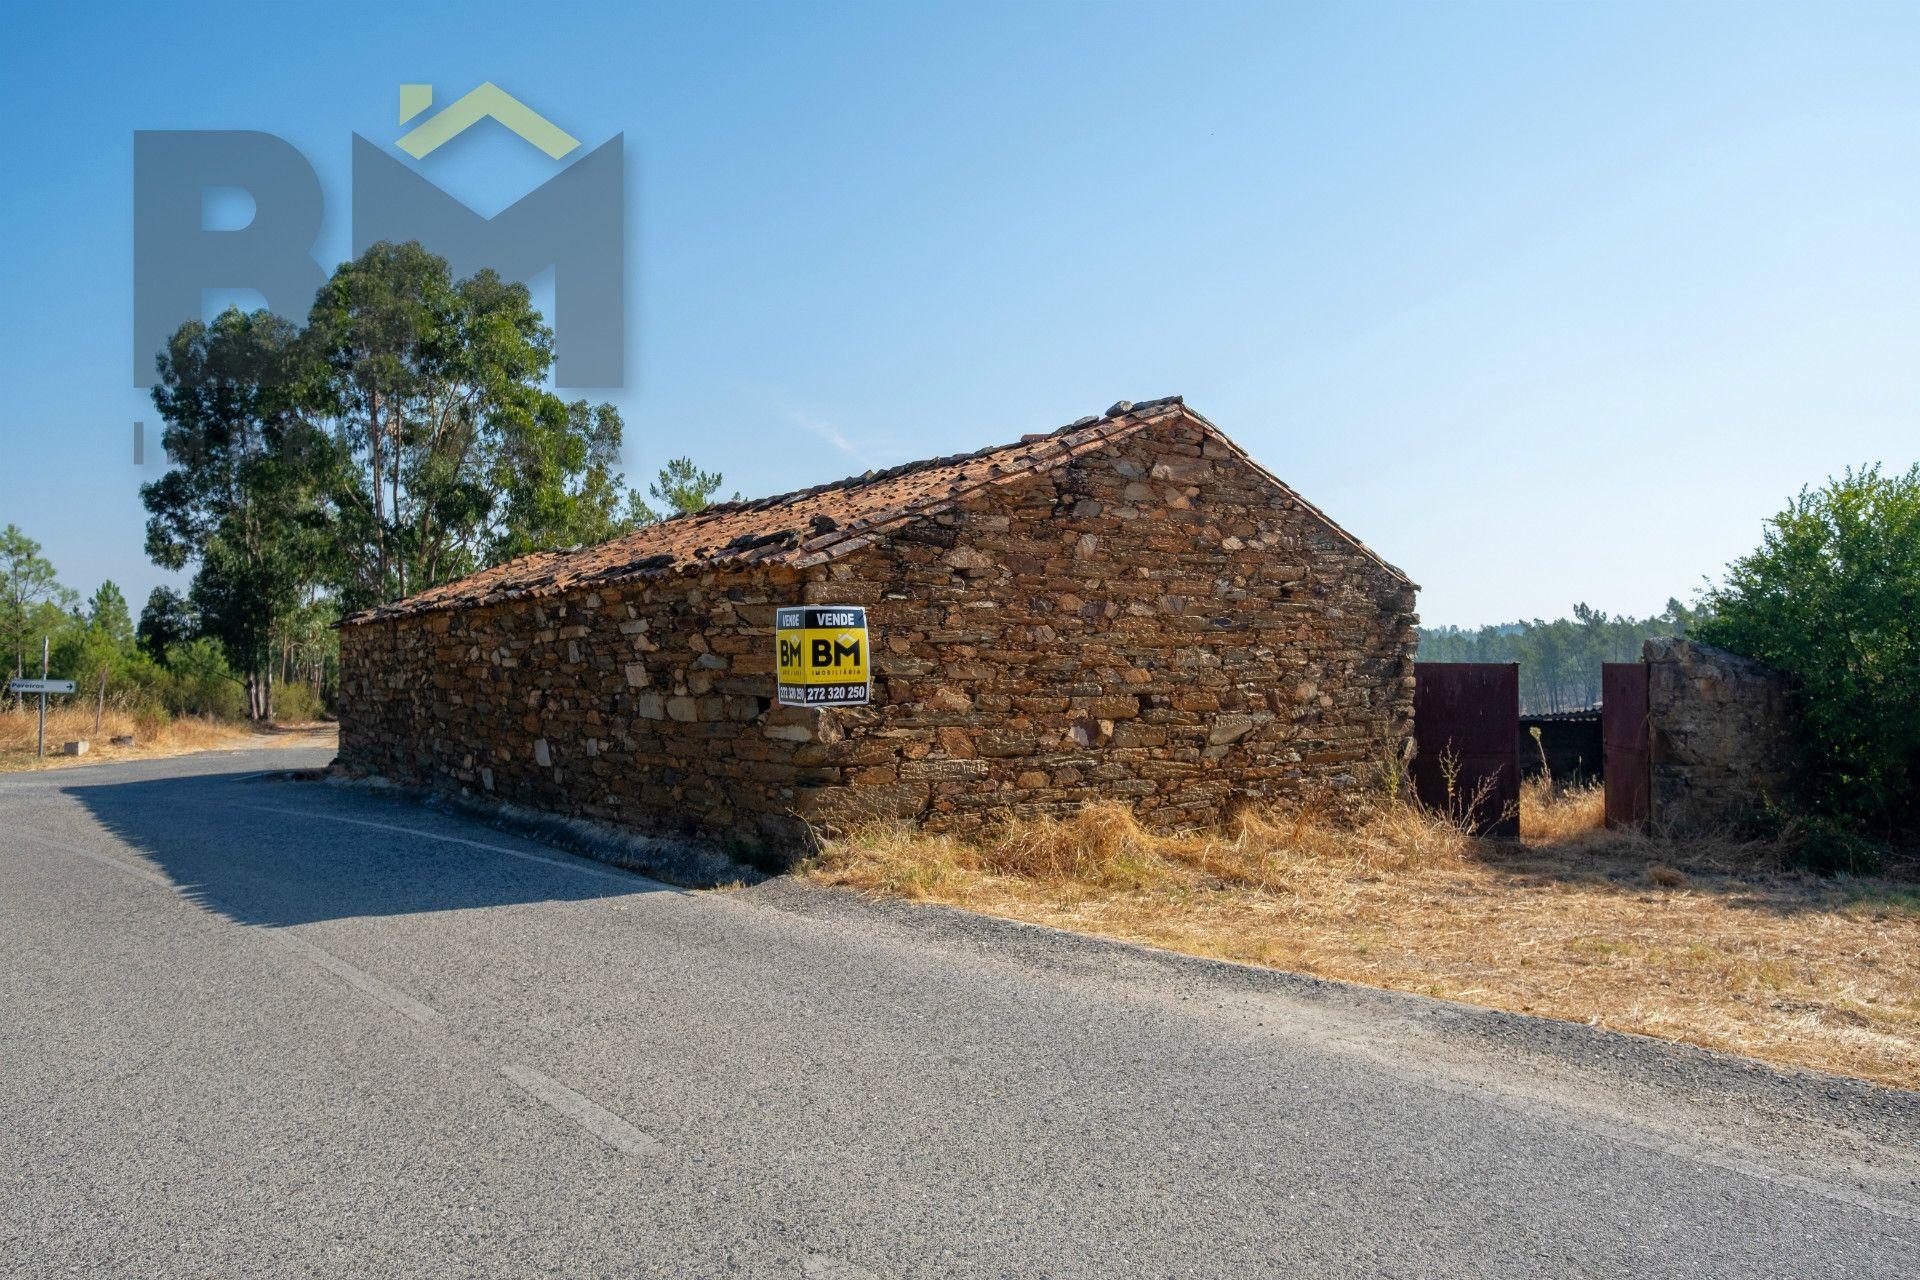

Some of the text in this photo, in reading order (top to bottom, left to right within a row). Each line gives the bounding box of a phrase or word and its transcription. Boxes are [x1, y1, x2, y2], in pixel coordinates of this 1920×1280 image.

[782, 614, 800, 627] VENDE
[817, 613, 855, 626] VENDE
[780, 639, 801, 667] BM
[812, 639, 860, 667] BM
[807, 685, 865, 700] 272 320 250
